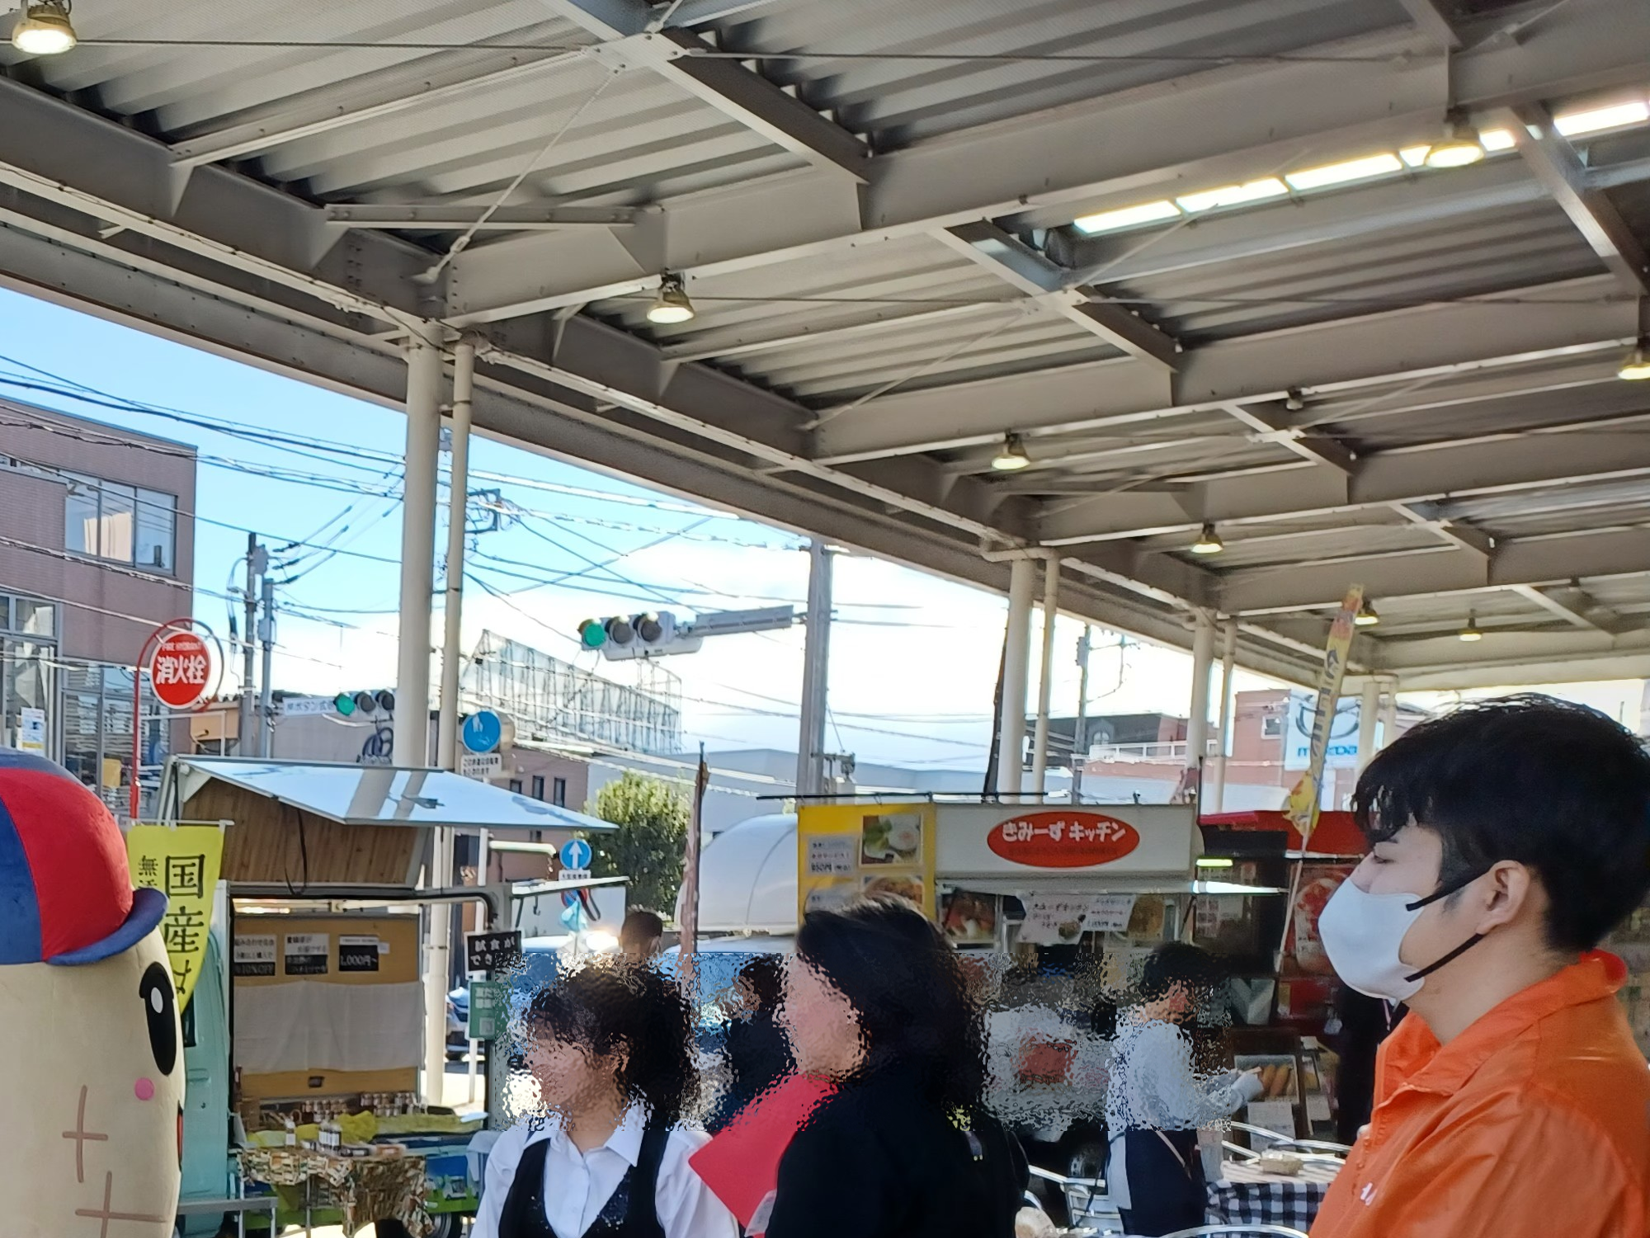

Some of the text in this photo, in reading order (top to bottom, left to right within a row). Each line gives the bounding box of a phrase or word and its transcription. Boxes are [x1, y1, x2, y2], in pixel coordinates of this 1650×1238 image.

[156, 654, 207, 685] 消火栓
[1002, 820, 1127, 843] きみーず キッチン
